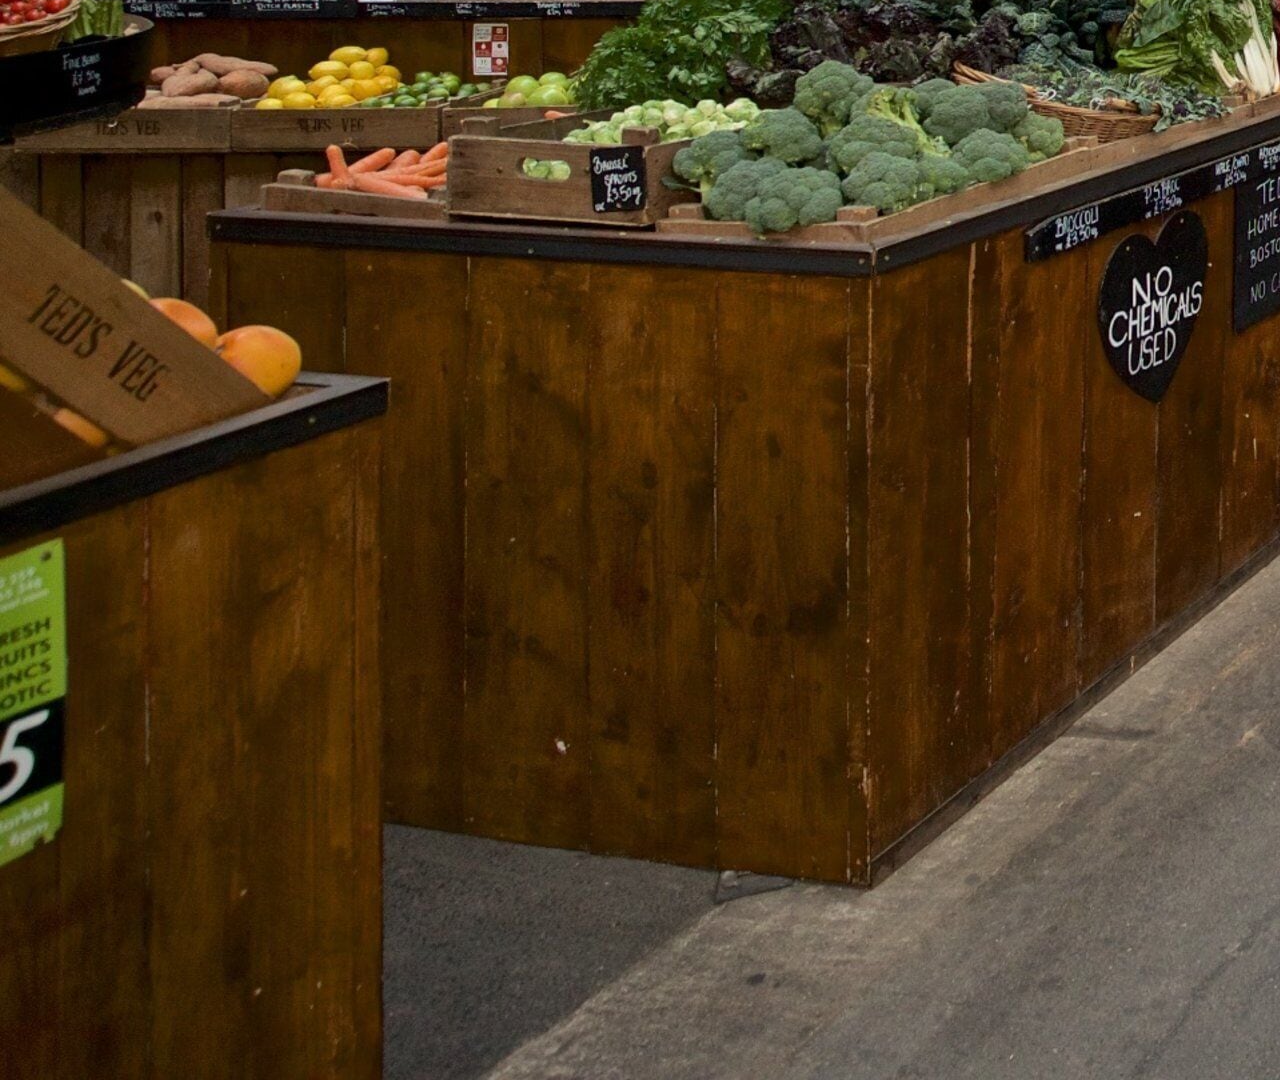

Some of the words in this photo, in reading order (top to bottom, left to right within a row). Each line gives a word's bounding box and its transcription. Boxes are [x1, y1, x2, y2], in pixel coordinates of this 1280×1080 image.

[1055, 206, 1099, 239] BROCCOLI
[1132, 266, 1172, 308] NO
[1250, 281, 1267, 305] NO
[1108, 281, 1204, 348] CHEMICALS
[28, 283, 114, 359] TED'S
[108, 340, 170, 402] VEG
[1128, 328, 1177, 375] USED
[0, 616, 51, 646] RESH
[0, 639, 51, 668] UITS
[0, 679, 51, 709] OTIC
[0, 709, 50, 803] 5
